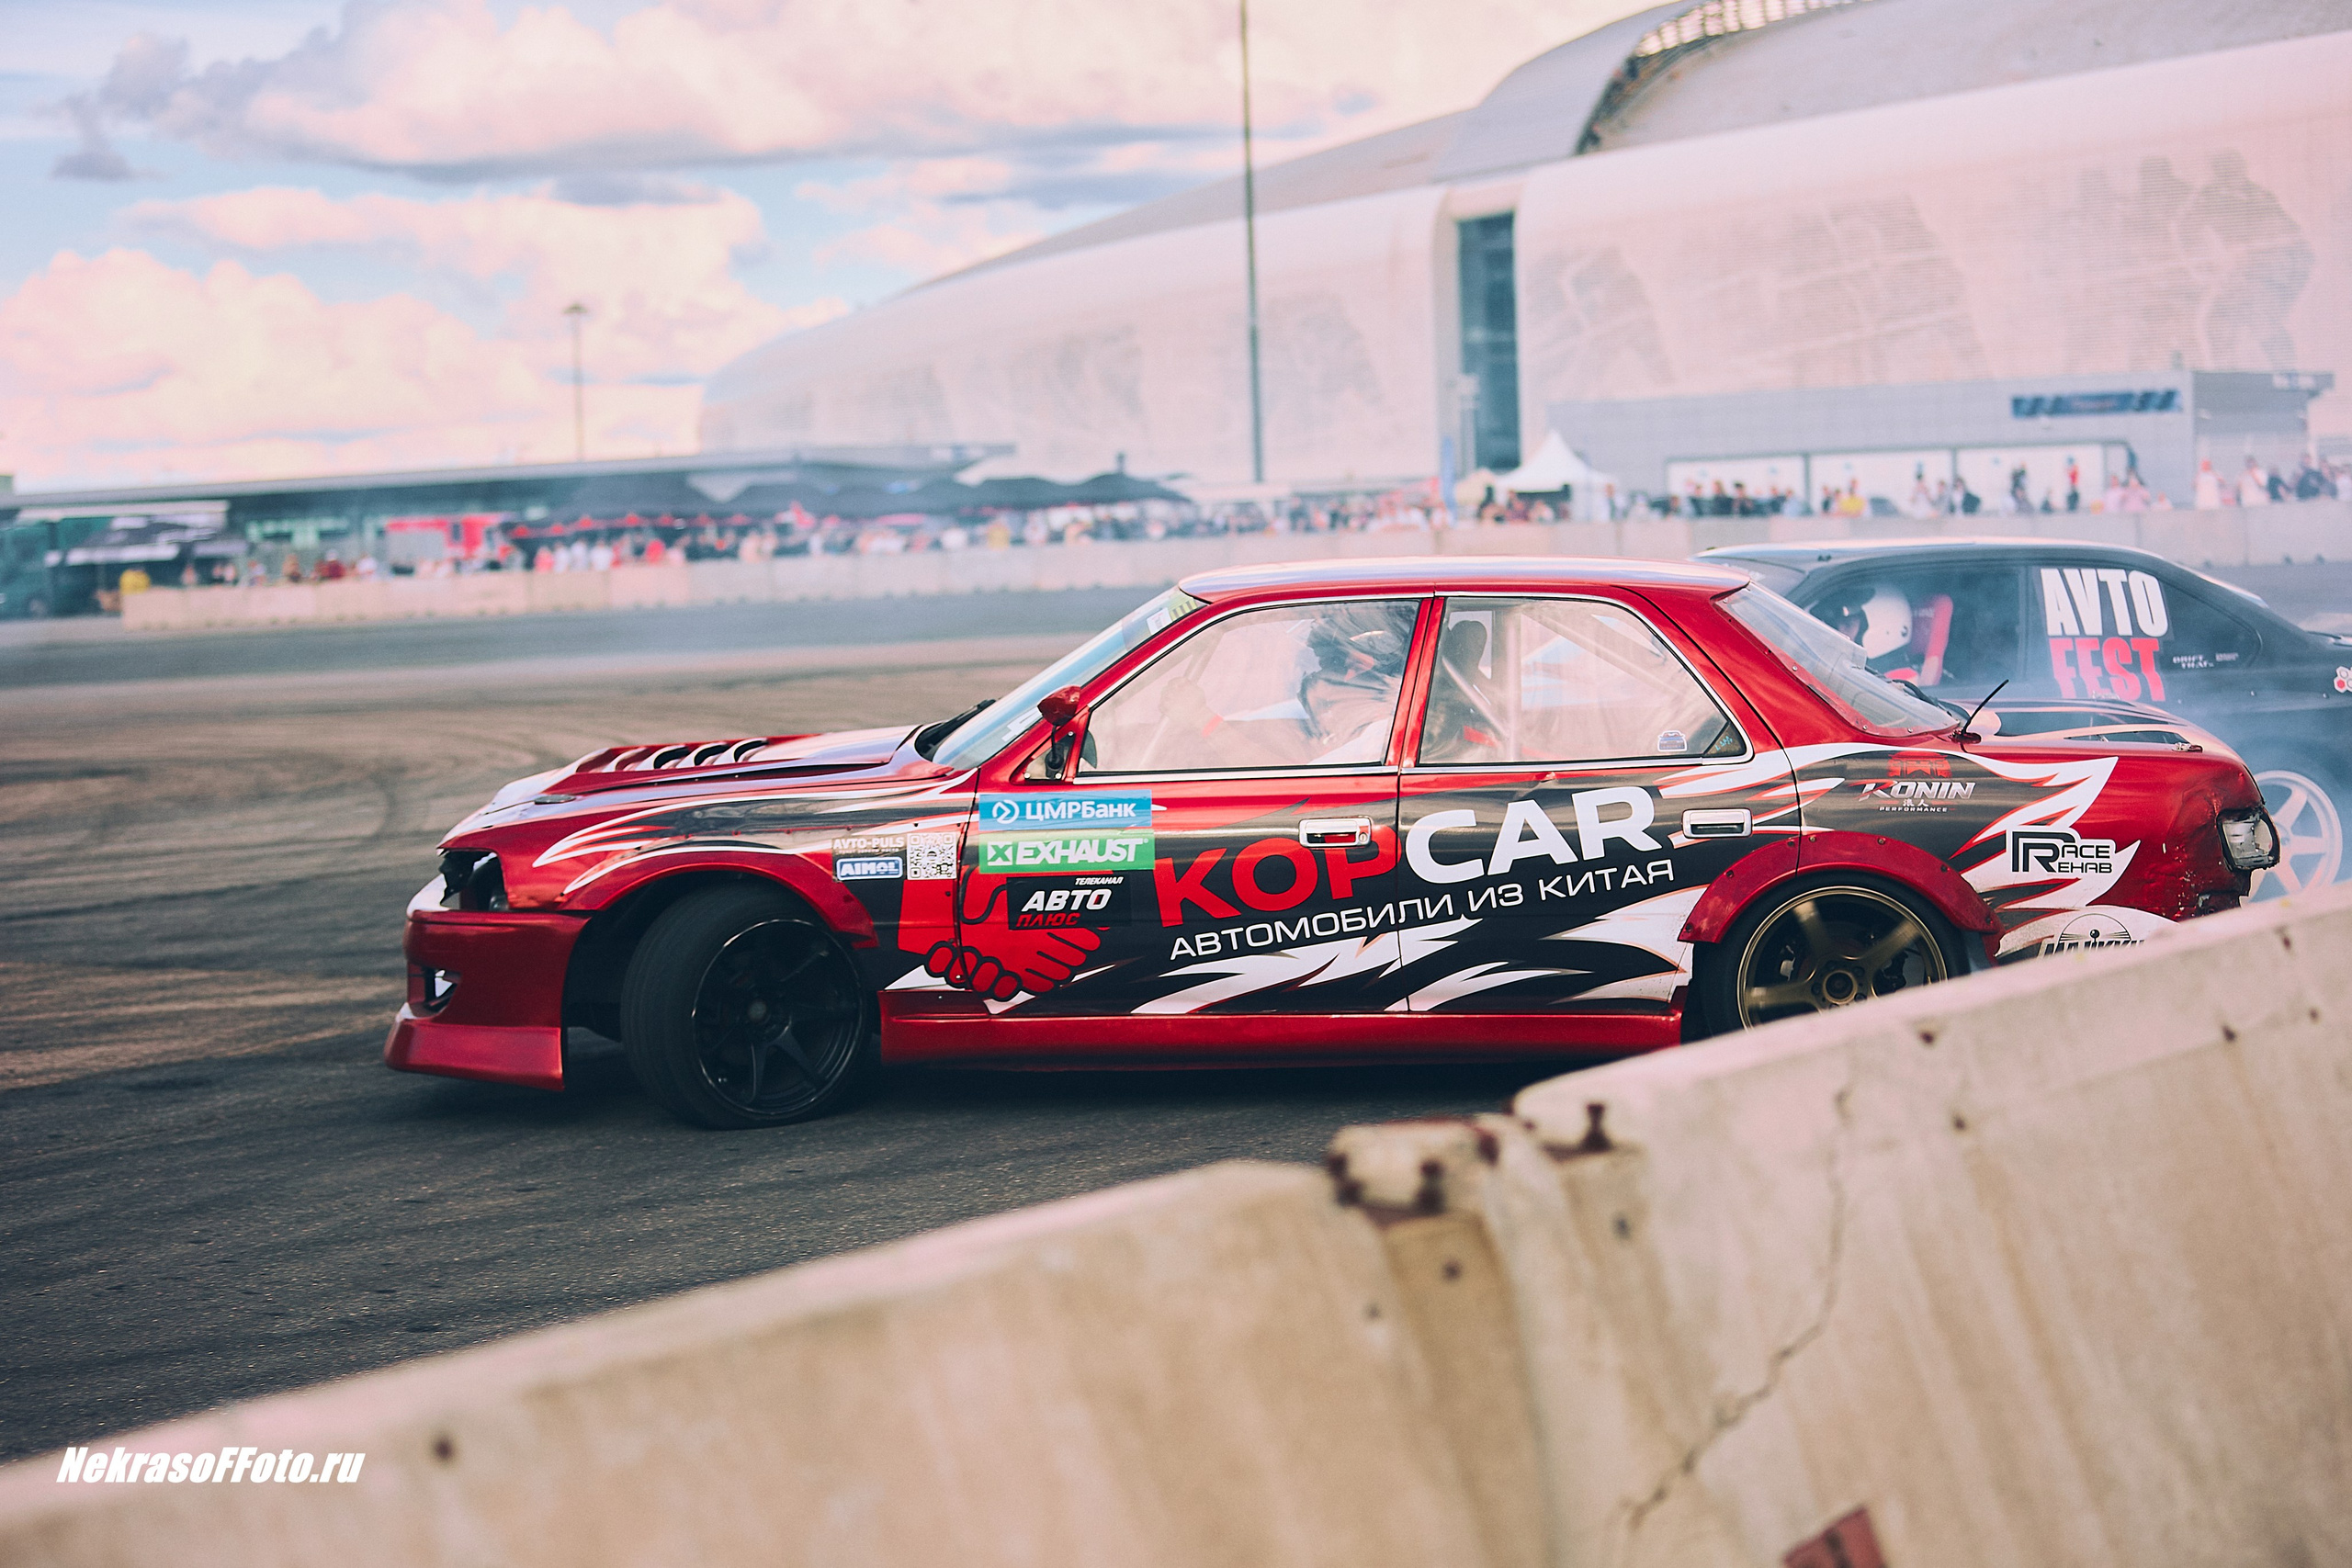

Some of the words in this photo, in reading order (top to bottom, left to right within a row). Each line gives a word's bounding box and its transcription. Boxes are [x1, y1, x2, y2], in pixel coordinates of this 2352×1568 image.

[2040, 568, 2168, 637] AVTO
[2049, 637, 2165, 703] FEST
[1849, 779, 1975, 801] RONIN
[1025, 801, 1136, 821] ЦМРБанк
[833, 836, 905, 849] AVTO-PULS
[1015, 838, 1145, 865] EXHAUST
[840, 862, 899, 876] AIMOL
[1075, 876, 1124, 886] ТЕЛЕКАНАЛ
[1021, 888, 1112, 912] АВТО
[1170, 894, 1454, 960] АВТОМОБИЛИ
[1469, 883, 1524, 913] ИЗ
[1539, 859, 1675, 902] КИТАЯ
[1015, 912, 1080, 927] ПЛЮС
